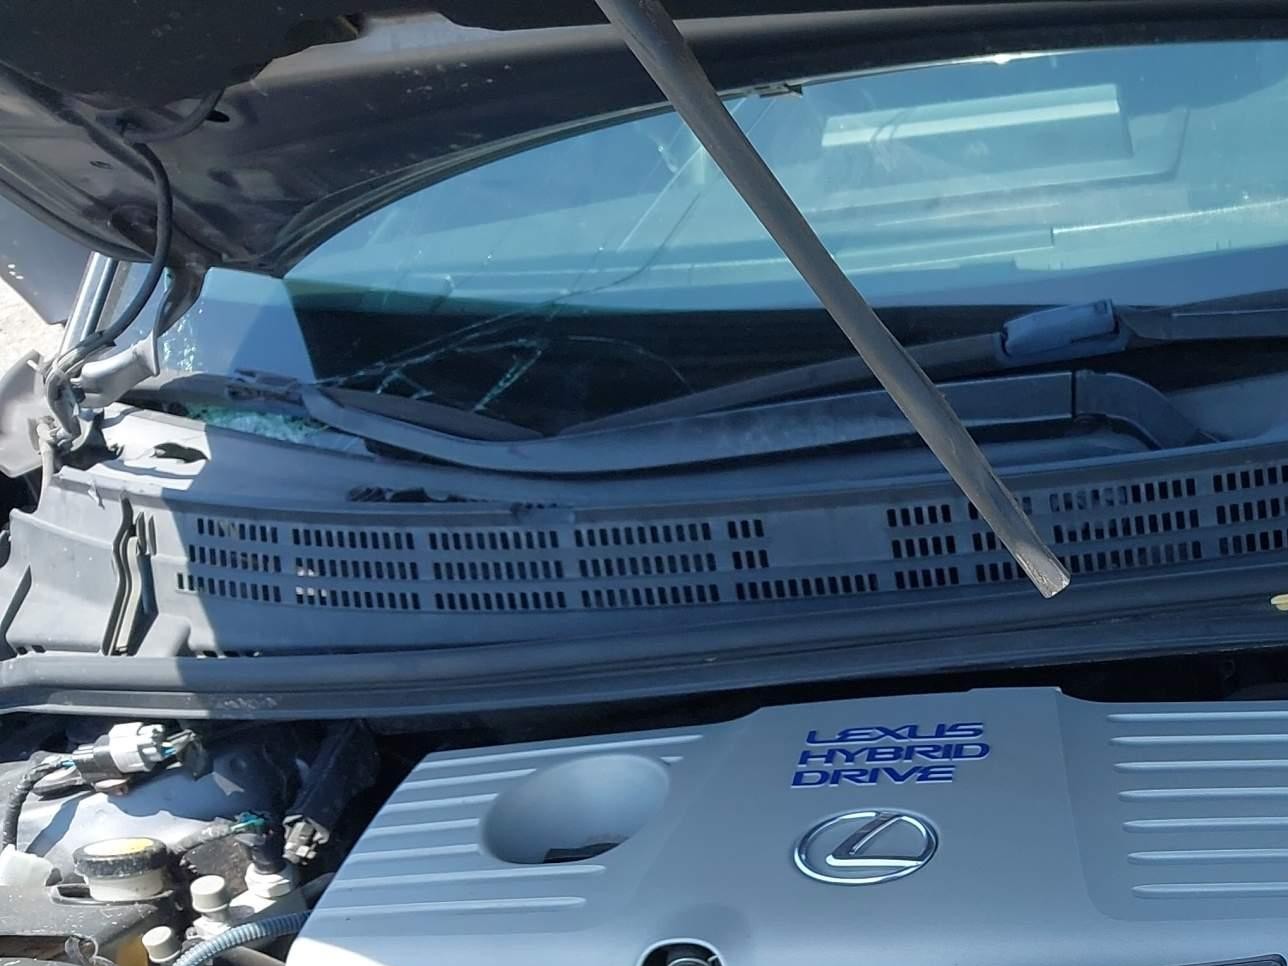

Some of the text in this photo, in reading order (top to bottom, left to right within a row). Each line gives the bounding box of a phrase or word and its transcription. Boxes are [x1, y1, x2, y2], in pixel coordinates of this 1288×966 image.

[805, 722, 984, 746] LEXUS
[797, 742, 990, 767] HYBRID
[790, 765, 956, 789] DRIVE
